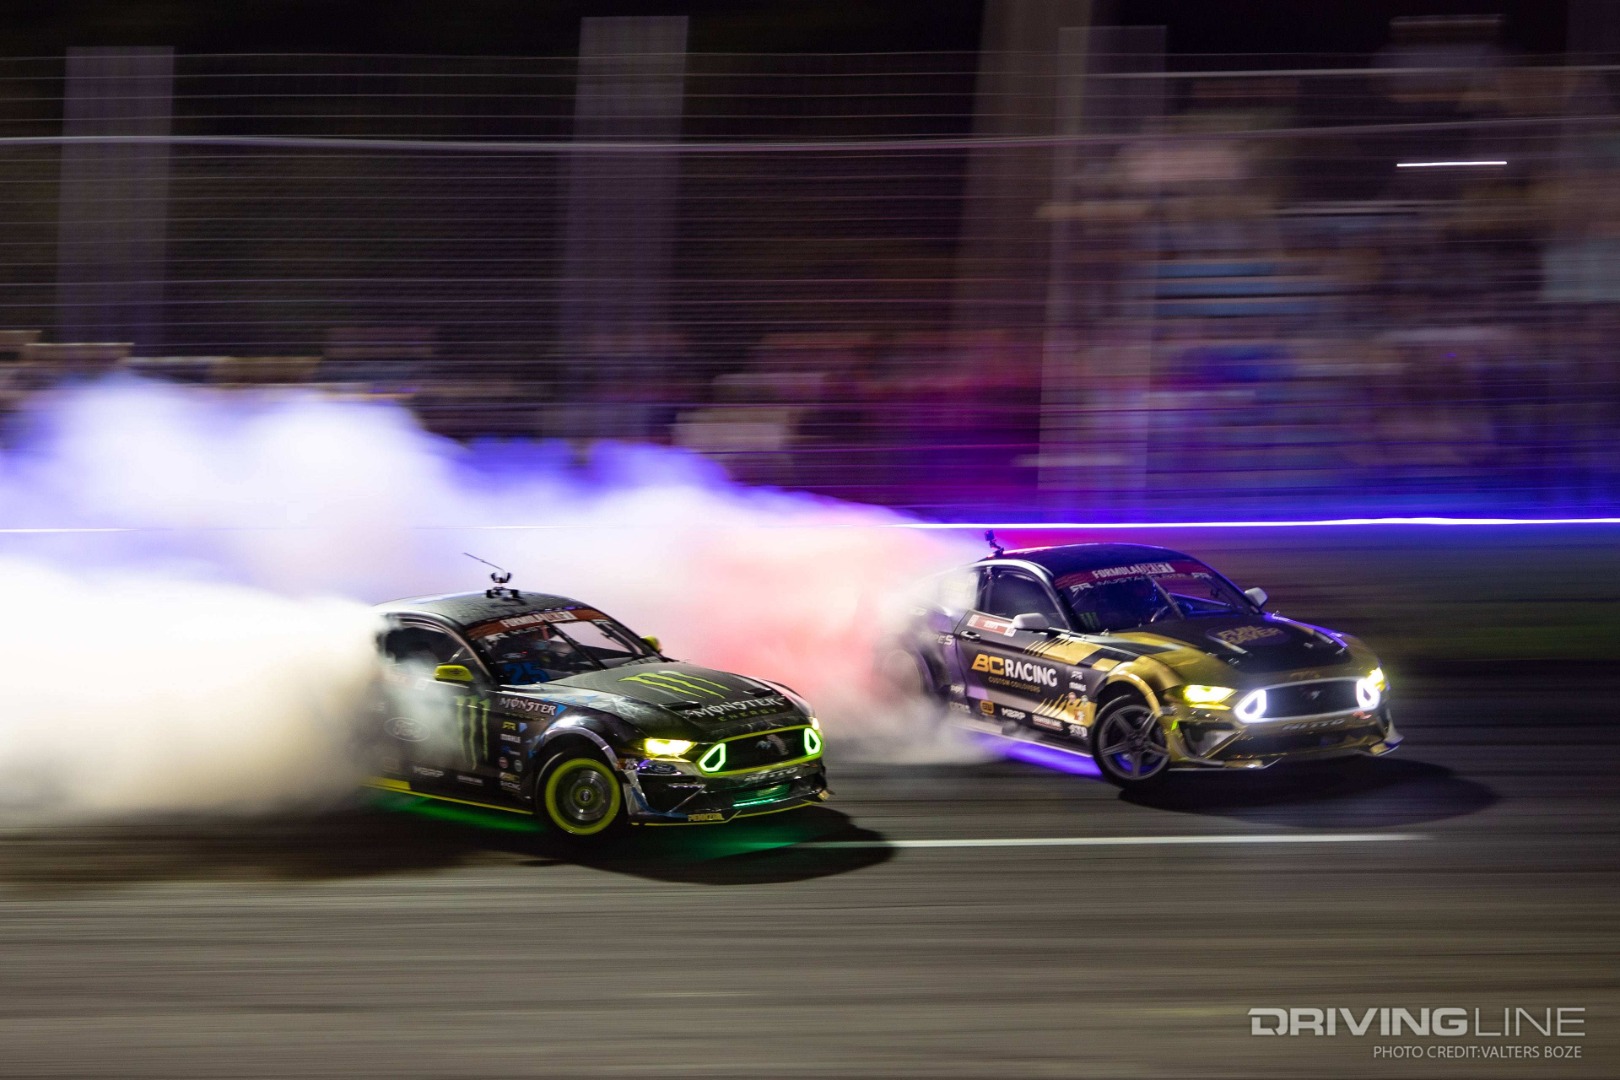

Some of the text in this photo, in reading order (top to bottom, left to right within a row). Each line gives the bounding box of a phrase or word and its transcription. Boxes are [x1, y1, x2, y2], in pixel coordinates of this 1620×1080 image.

[1092, 566, 1143, 579] FORMULA
[503, 661, 550, 686] 25
[500, 697, 557, 716] MONSTER
[684, 697, 785, 719] MONSTER
